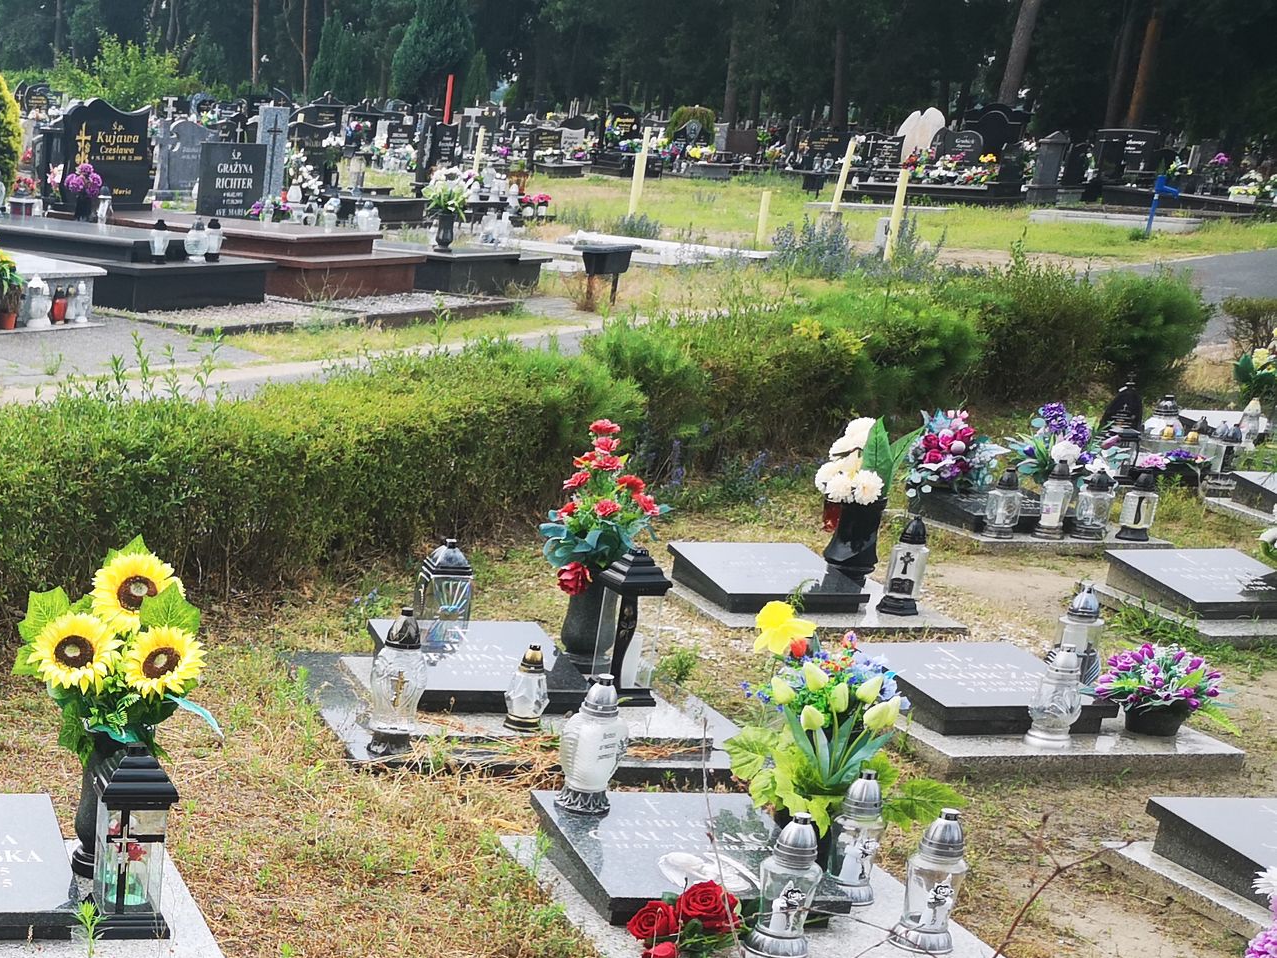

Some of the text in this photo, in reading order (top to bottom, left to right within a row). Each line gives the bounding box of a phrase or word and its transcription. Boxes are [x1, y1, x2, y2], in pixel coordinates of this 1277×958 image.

[96, 131, 141, 146] Kujawa
[216, 161, 254, 174] GRAŻYNA
[214, 177, 254, 190] RICHTER
